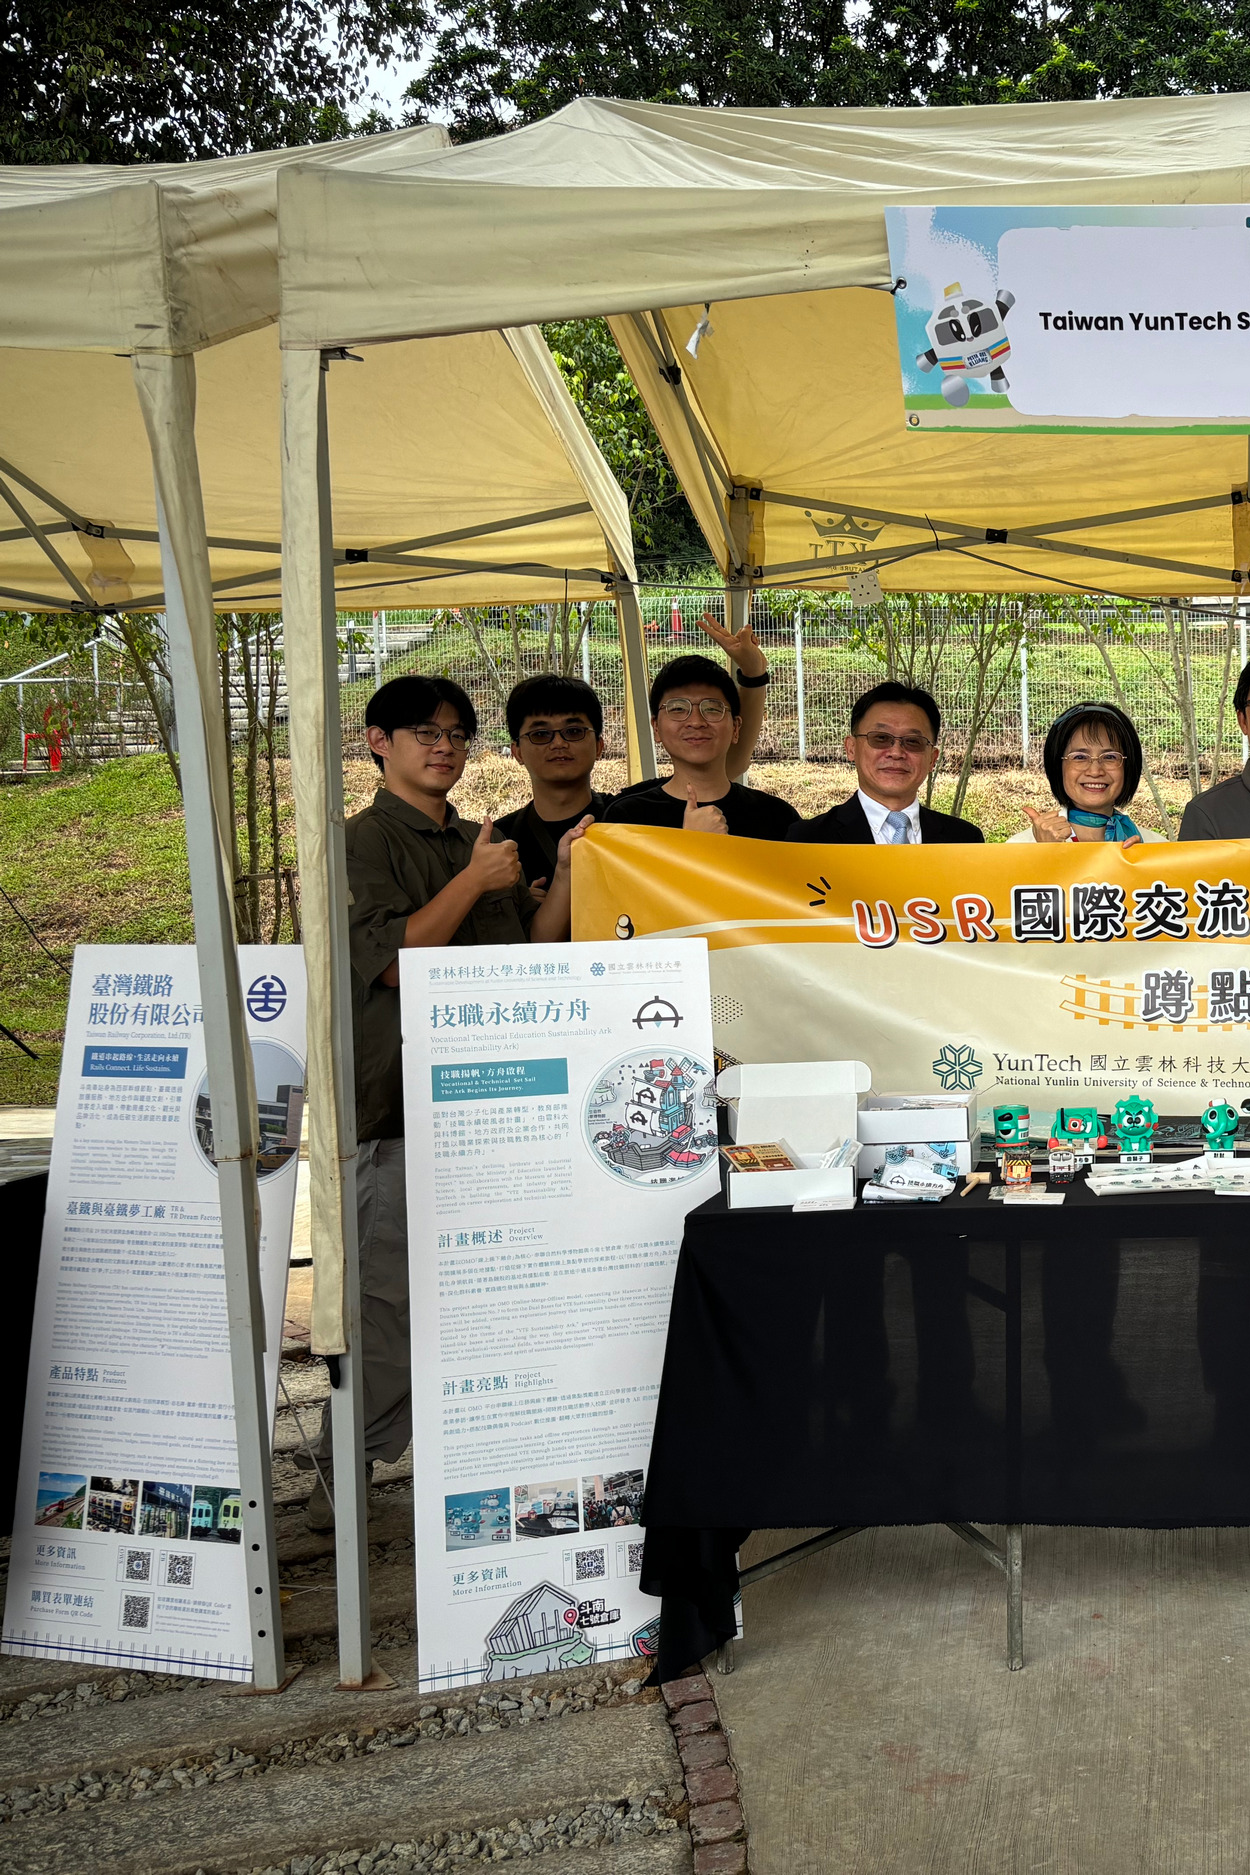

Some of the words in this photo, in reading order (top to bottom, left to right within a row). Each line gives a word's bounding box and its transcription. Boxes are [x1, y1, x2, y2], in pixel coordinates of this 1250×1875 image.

[1039, 310, 1124, 331] Taiwan
[1129, 308, 1232, 331] YunTech
[854, 896, 996, 947] USR
[428, 962, 570, 980] 雲林科技大學永續發展
[92, 973, 173, 997] 臺灣鐵路
[88, 1003, 204, 1027] 股份有限公司
[430, 998, 591, 1029] 技職永續方舟
[107, 1031, 130, 1040] Railway
[131, 1032, 166, 1040] Corporation,
[430, 1034, 470, 1043] Vocational
[472, 1032, 507, 1041] Technical
[509, 1030, 546, 1040] Education
[548, 1028, 597, 1039] Sustainability
[599, 1027, 612, 1035] Ark
[430, 1044, 449, 1055] (VTE
[451, 1043, 502, 1054] Sustainability
[504, 1042, 520, 1052] Ark)
[90, 1063, 104, 1071] Rails
[105, 1064, 131, 1072] Connect.
[132, 1064, 144, 1072] Life
[145, 1064, 171, 1072] Sustains.
[993, 1053, 1081, 1072] YunTech
[996, 1076, 1039, 1087] National
[1044, 1076, 1079, 1088] Yunlin
[1084, 1077, 1138, 1089] University
[1142, 1077, 1153, 1087] of
[1157, 1077, 1196, 1088] Science
[1200, 1078, 1208, 1088] &
[66, 1201, 166, 1219] 臺鐵與臺鐵夢工廠
[200, 1214, 222, 1222] Factory
[437, 1229, 503, 1249] 計畫概述
[508, 1233, 544, 1242] Overview
[509, 1226, 535, 1236] Project
[49, 1365, 99, 1383] 產品特點
[102, 1376, 127, 1384] Features
[514, 1371, 541, 1382] Project
[442, 1375, 509, 1396] 計畫亮點
[514, 1377, 554, 1388] Highlights
[36, 1544, 77, 1560] 更多資訊
[34, 1559, 51, 1567] More
[52, 1560, 86, 1571] Information
[452, 1566, 508, 1587] 更多資訊
[452, 1588, 473, 1596] More
[475, 1580, 522, 1593] Information
[31, 1590, 94, 1608] 購買表單連結
[580, 1599, 605, 1614] 斗南
[30, 1606, 54, 1615] Purchase
[55, 1608, 70, 1616] Form
[70, 1610, 79, 1618] QR
[80, 1610, 94, 1618] Code
